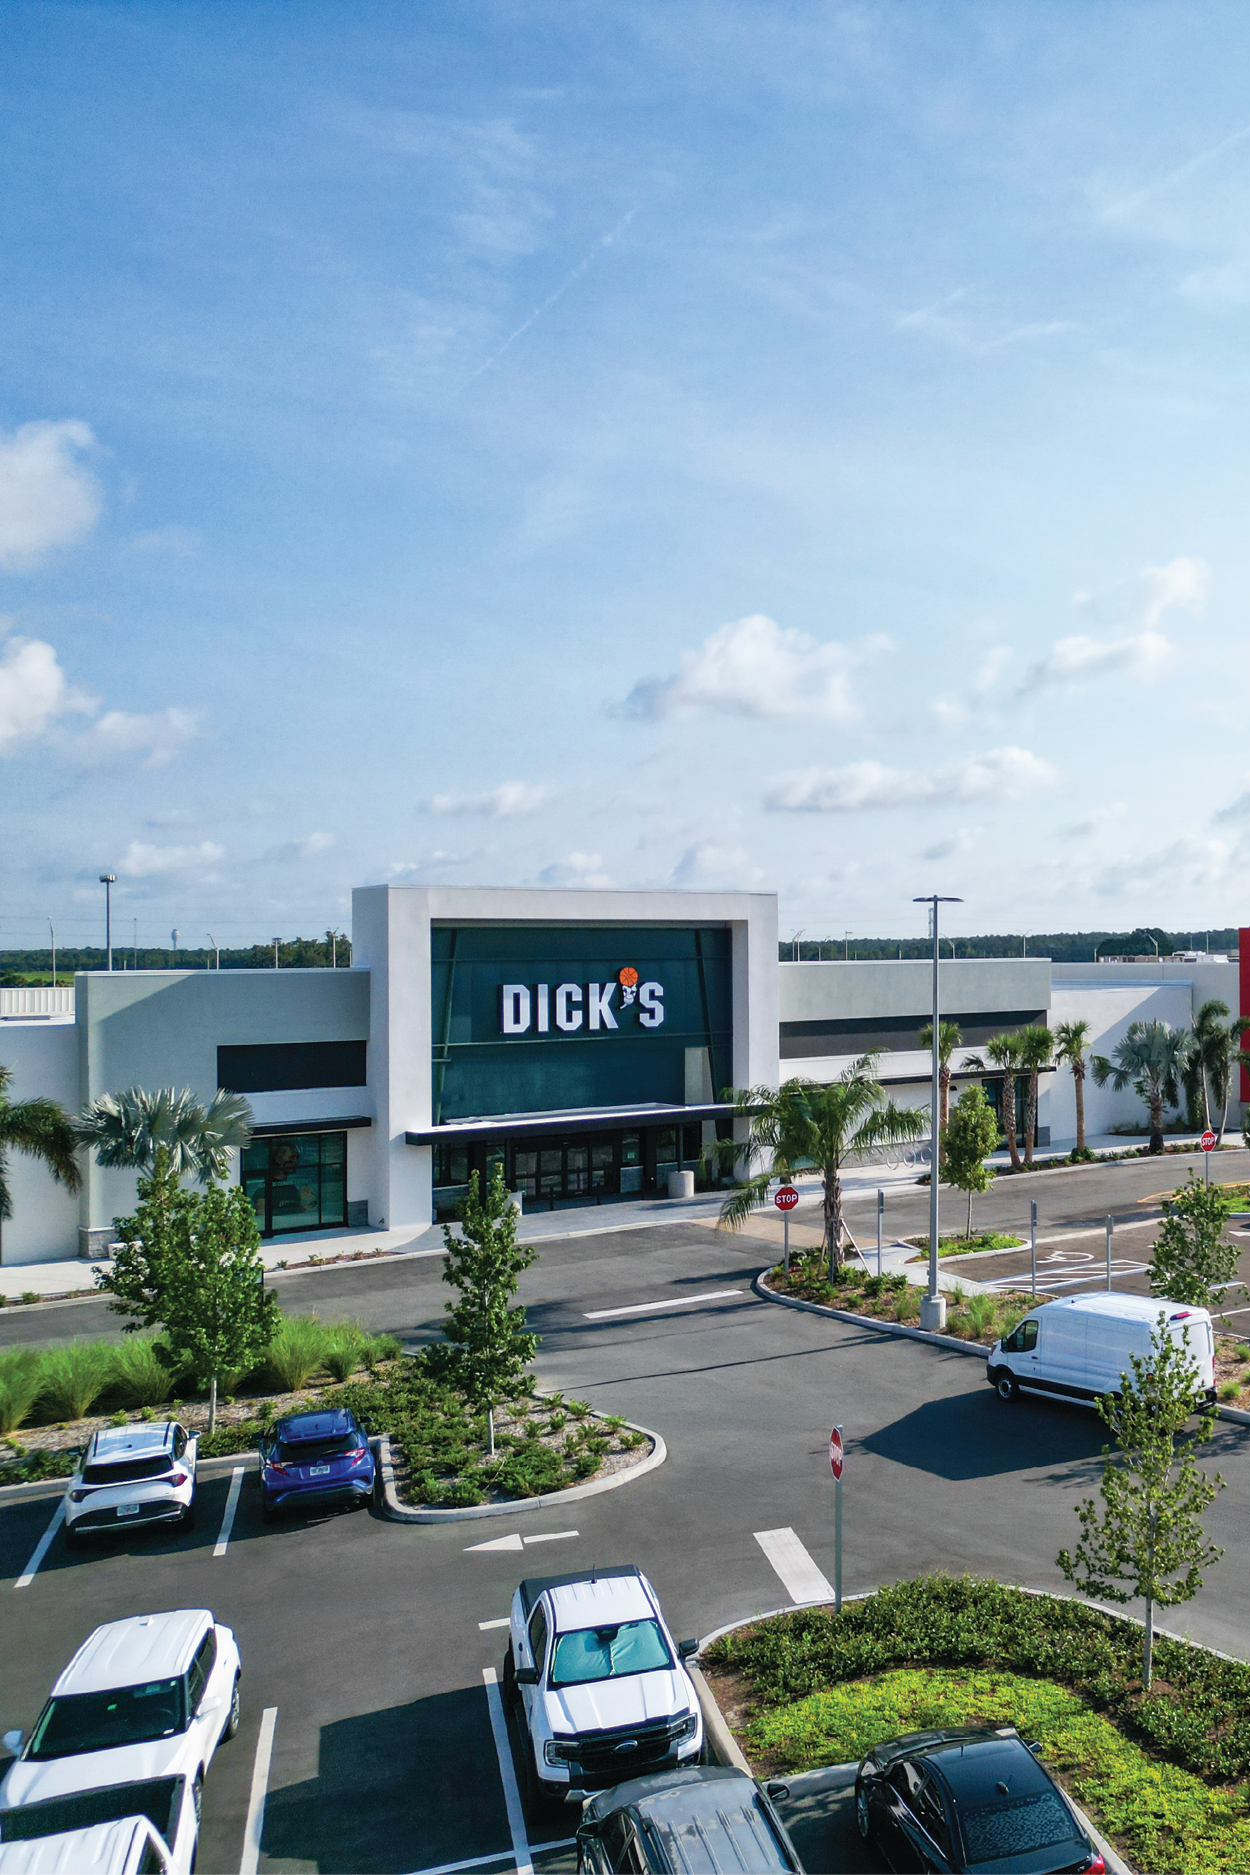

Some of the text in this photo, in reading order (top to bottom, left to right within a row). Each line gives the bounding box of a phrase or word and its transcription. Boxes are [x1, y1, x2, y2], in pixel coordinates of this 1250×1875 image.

[503, 979, 664, 1034] DICK'S
[1202, 1136, 1215, 1146] STOP
[776, 1194, 798, 1204] STOP
[830, 1441, 842, 1467] STOP
